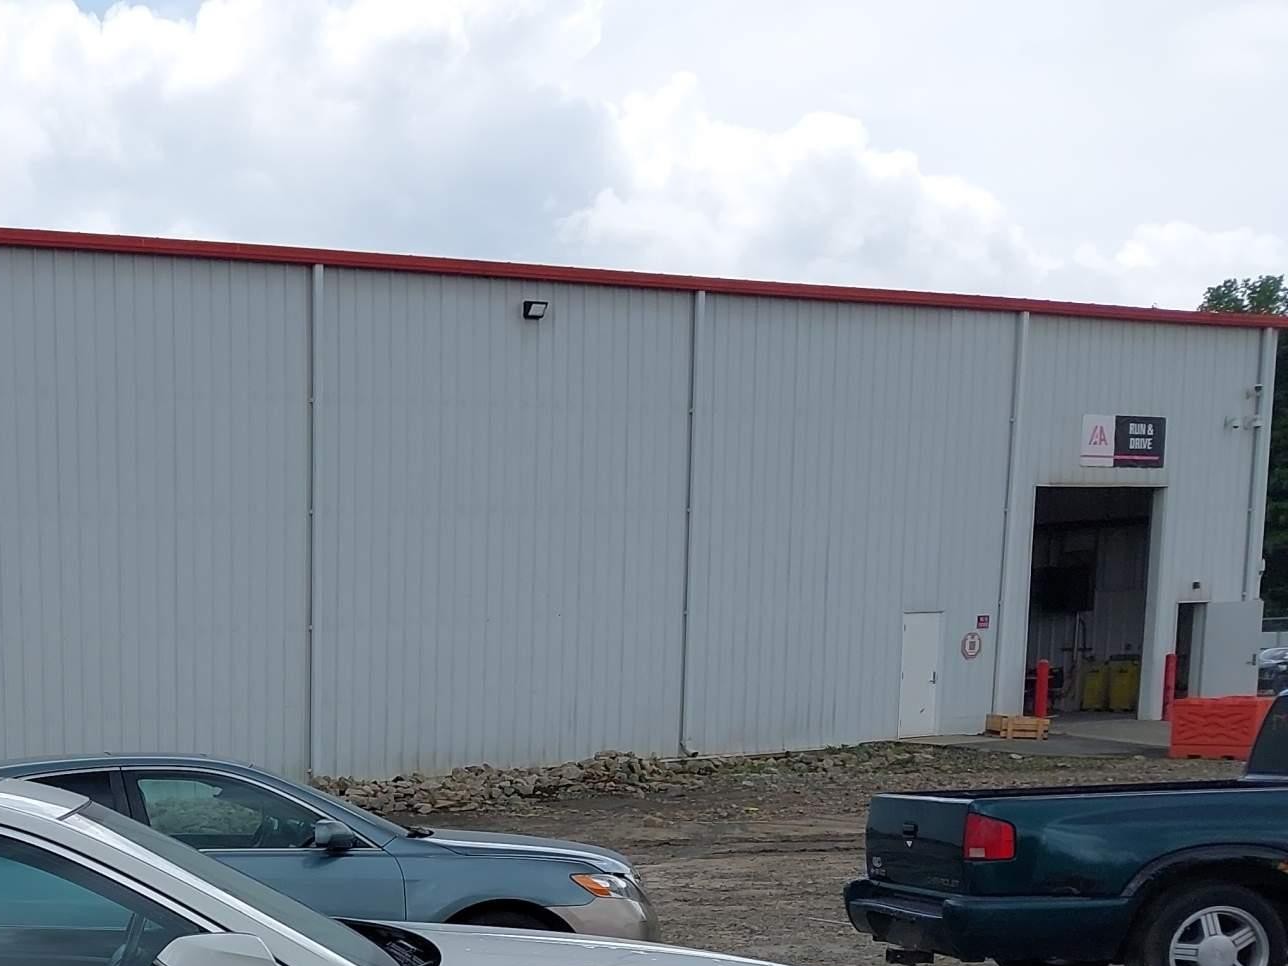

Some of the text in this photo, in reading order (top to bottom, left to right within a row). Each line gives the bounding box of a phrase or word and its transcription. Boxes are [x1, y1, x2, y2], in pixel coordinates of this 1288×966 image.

[1129, 423, 1154, 435] RUN &
[1129, 437, 1153, 450] DRIVE
